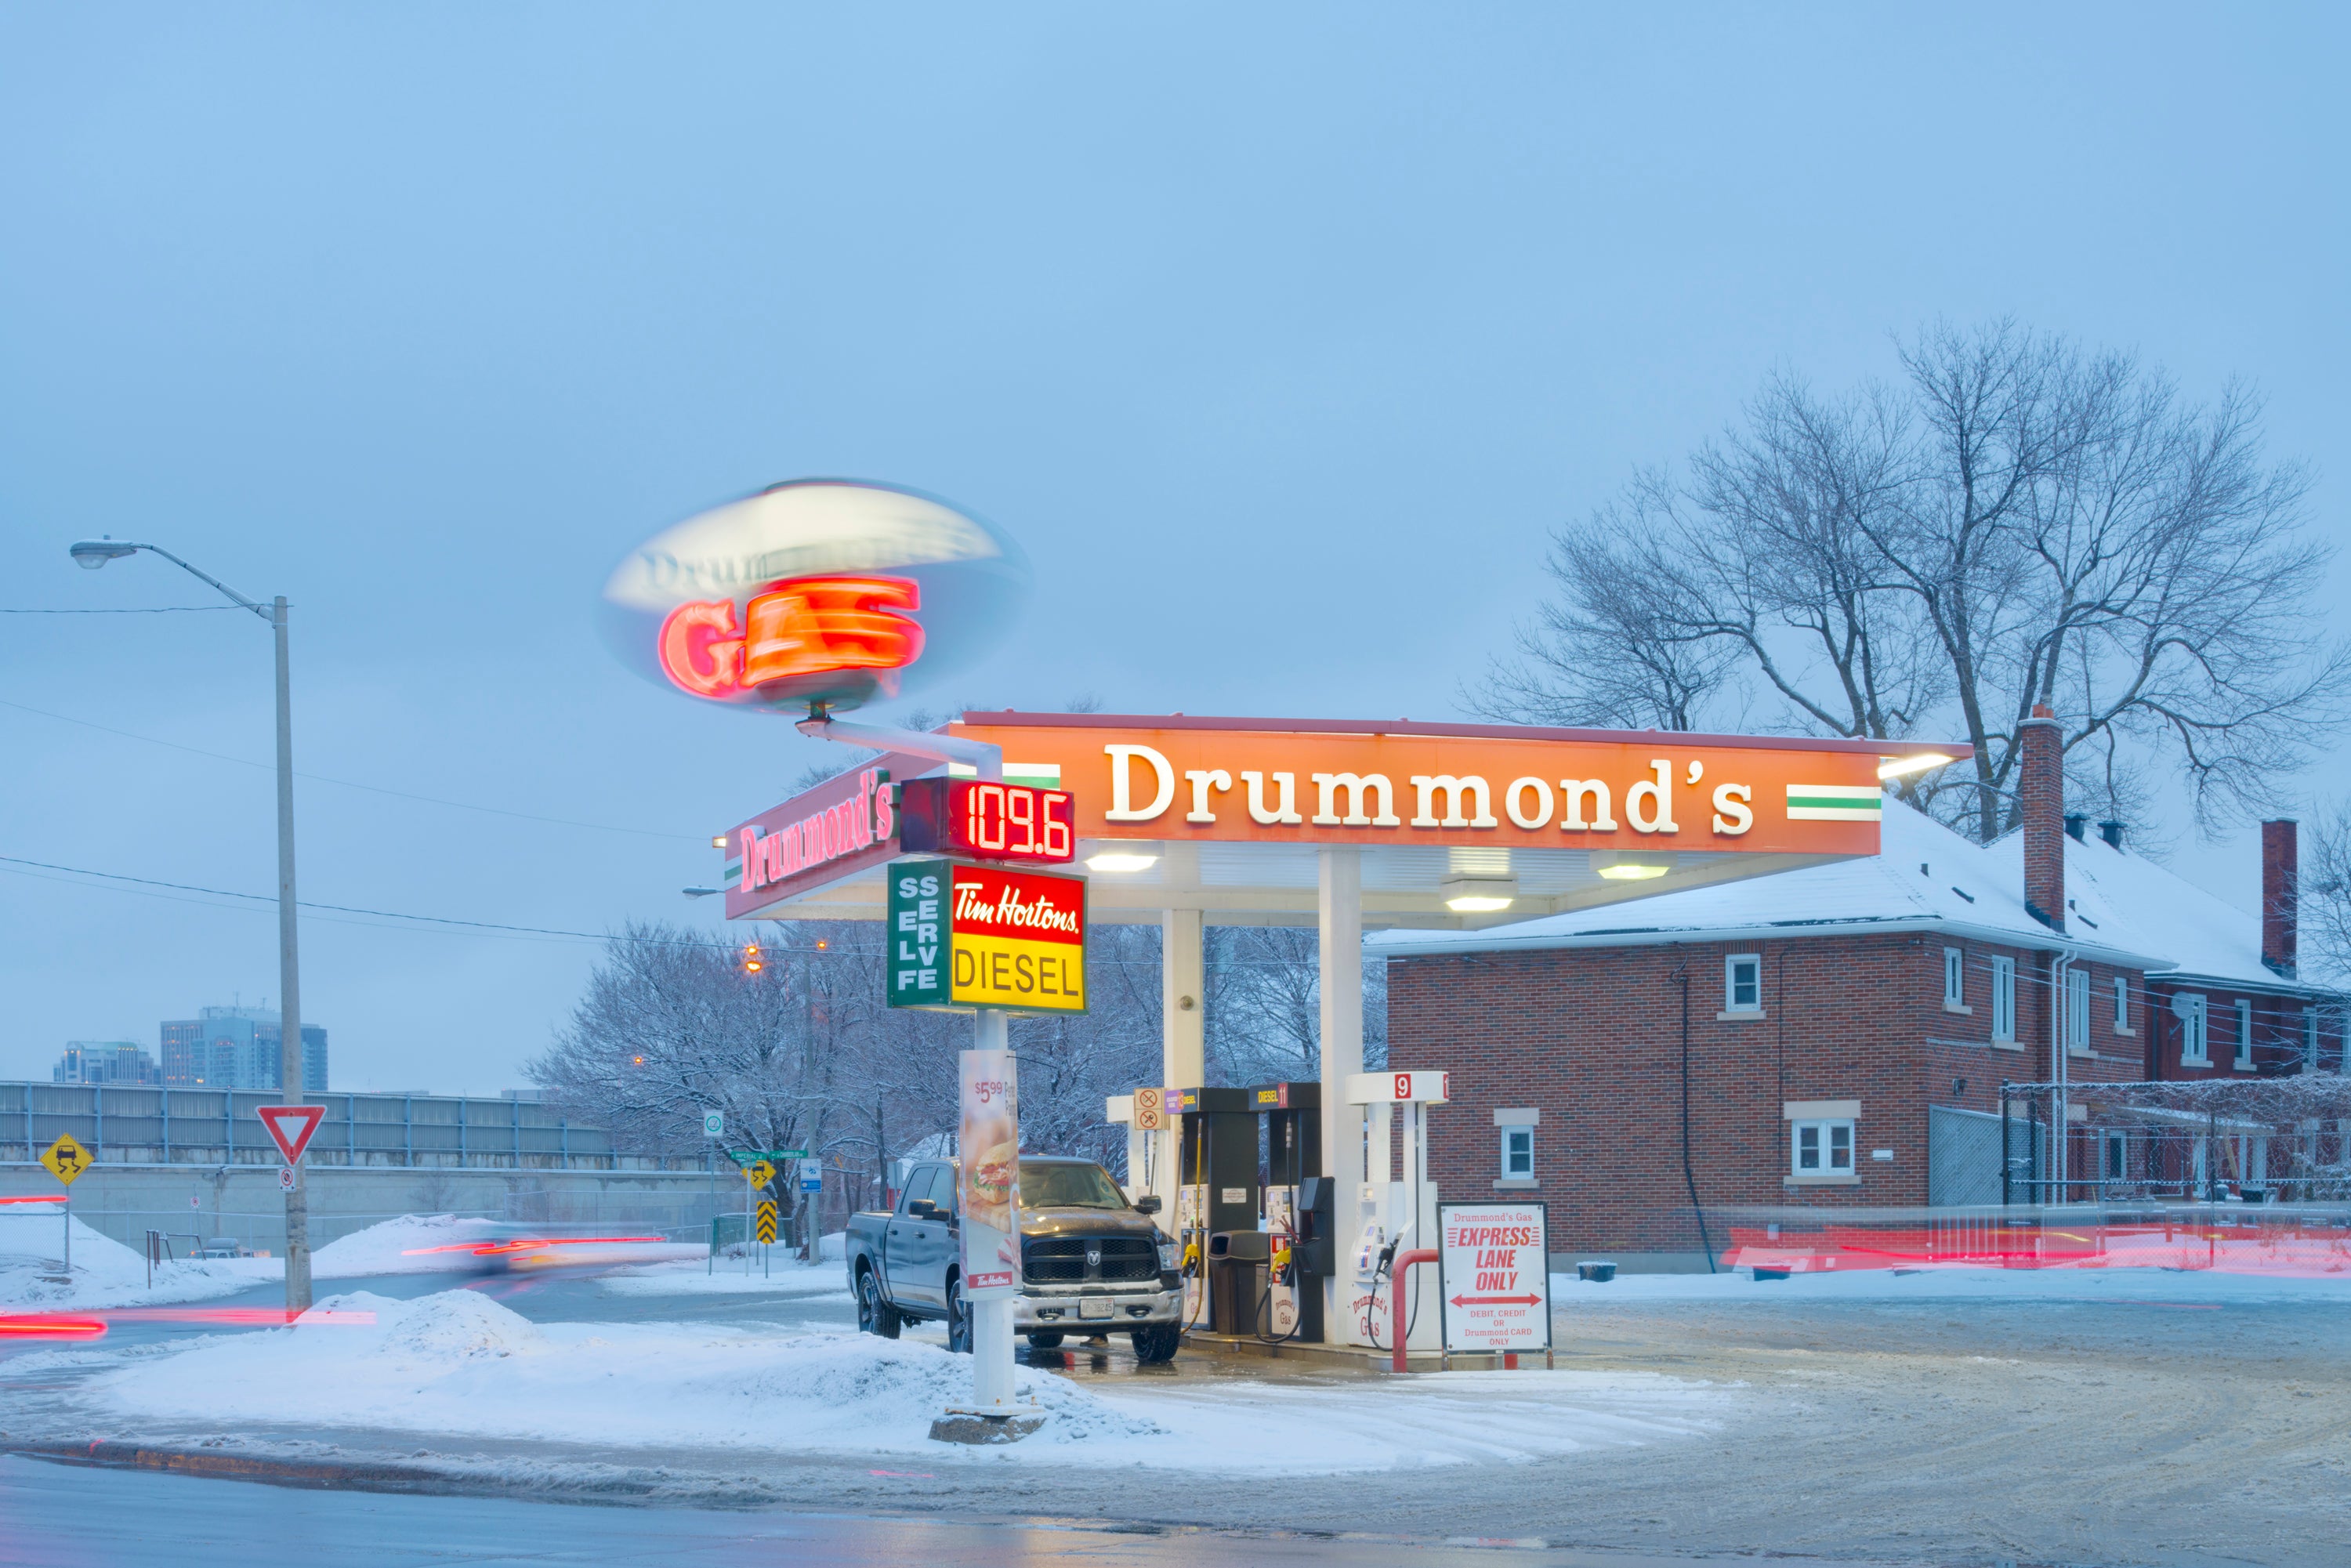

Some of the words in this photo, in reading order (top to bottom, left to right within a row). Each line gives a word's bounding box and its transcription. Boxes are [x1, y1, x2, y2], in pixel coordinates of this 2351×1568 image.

[1103, 744, 1754, 835] Drummond's
[968, 785, 1070, 856] 109.6
[741, 768, 893, 893] Drummond's
[954, 882, 993, 924] Tim
[955, 948, 1079, 997] DIESEL
[1258, 1090, 1278, 1103] DIESEL
[1280, 1087, 1286, 1105] 11
[1397, 1077, 1408, 1096] 9
[1454, 1213, 1513, 1222] Drummond's
[1458, 1227, 1531, 1246] EXPRESS
[1476, 1249, 1516, 1269] LANE
[977, 1276, 987, 1286] Tim
[1476, 1271, 1519, 1291] ONLY
[1280, 1312, 1291, 1325] Gas
[1465, 1328, 1509, 1337] Drummond
